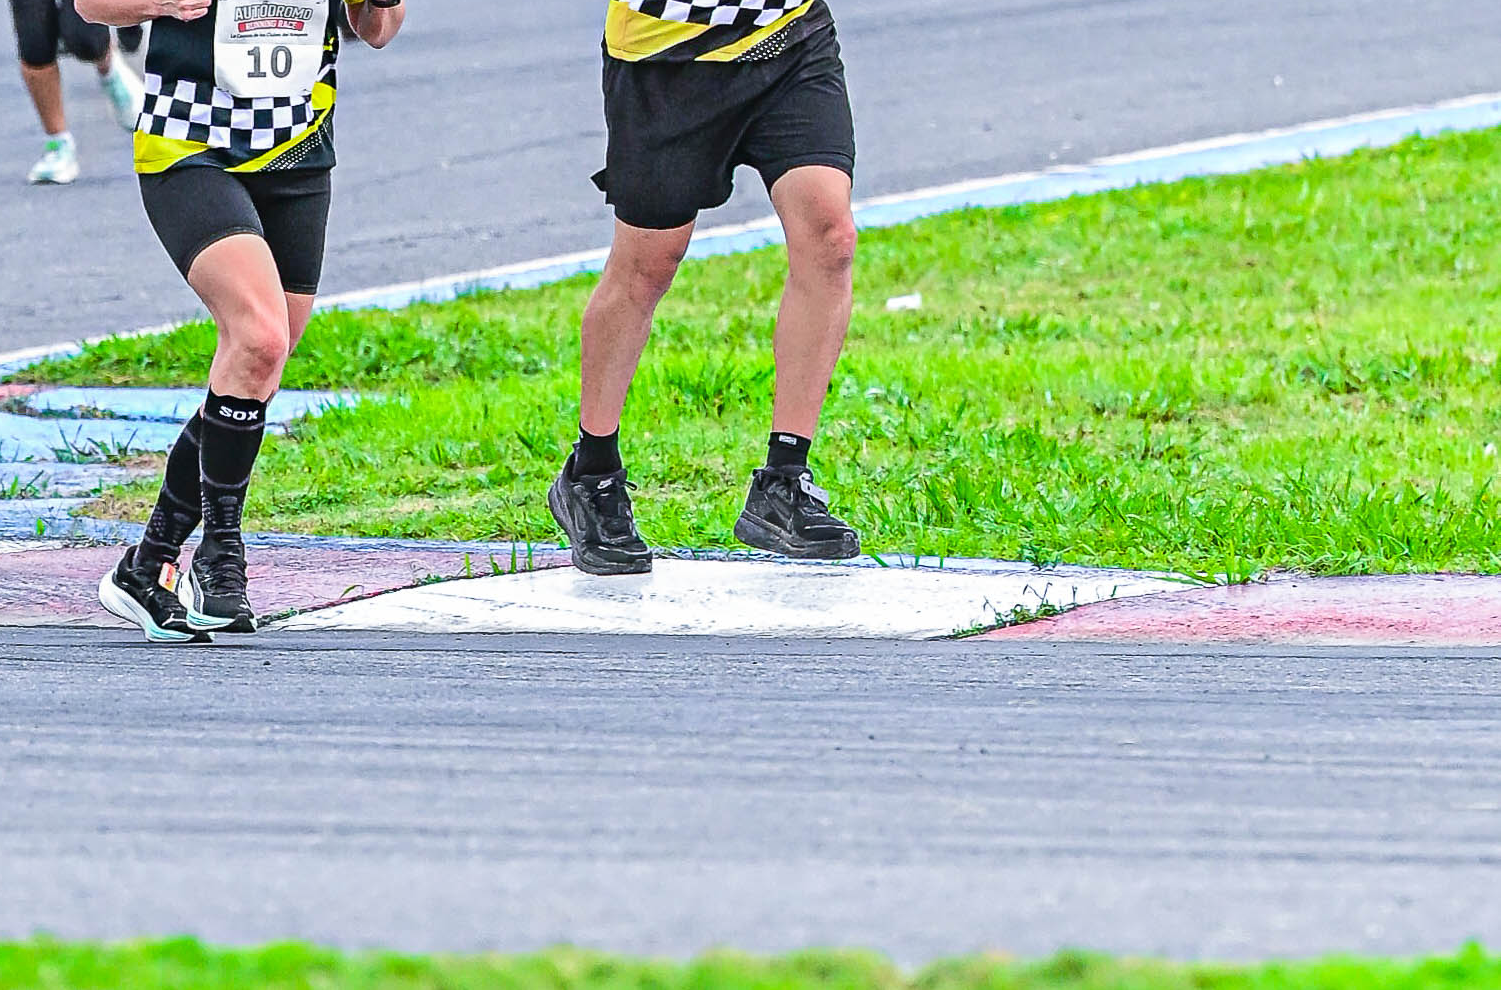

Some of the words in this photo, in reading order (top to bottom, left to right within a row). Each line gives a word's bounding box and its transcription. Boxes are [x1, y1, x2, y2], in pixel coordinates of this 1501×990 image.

[234, 0, 313, 21] AUTÓDROMO
[247, 45, 292, 78] 10
[218, 405, 259, 421] SOX
